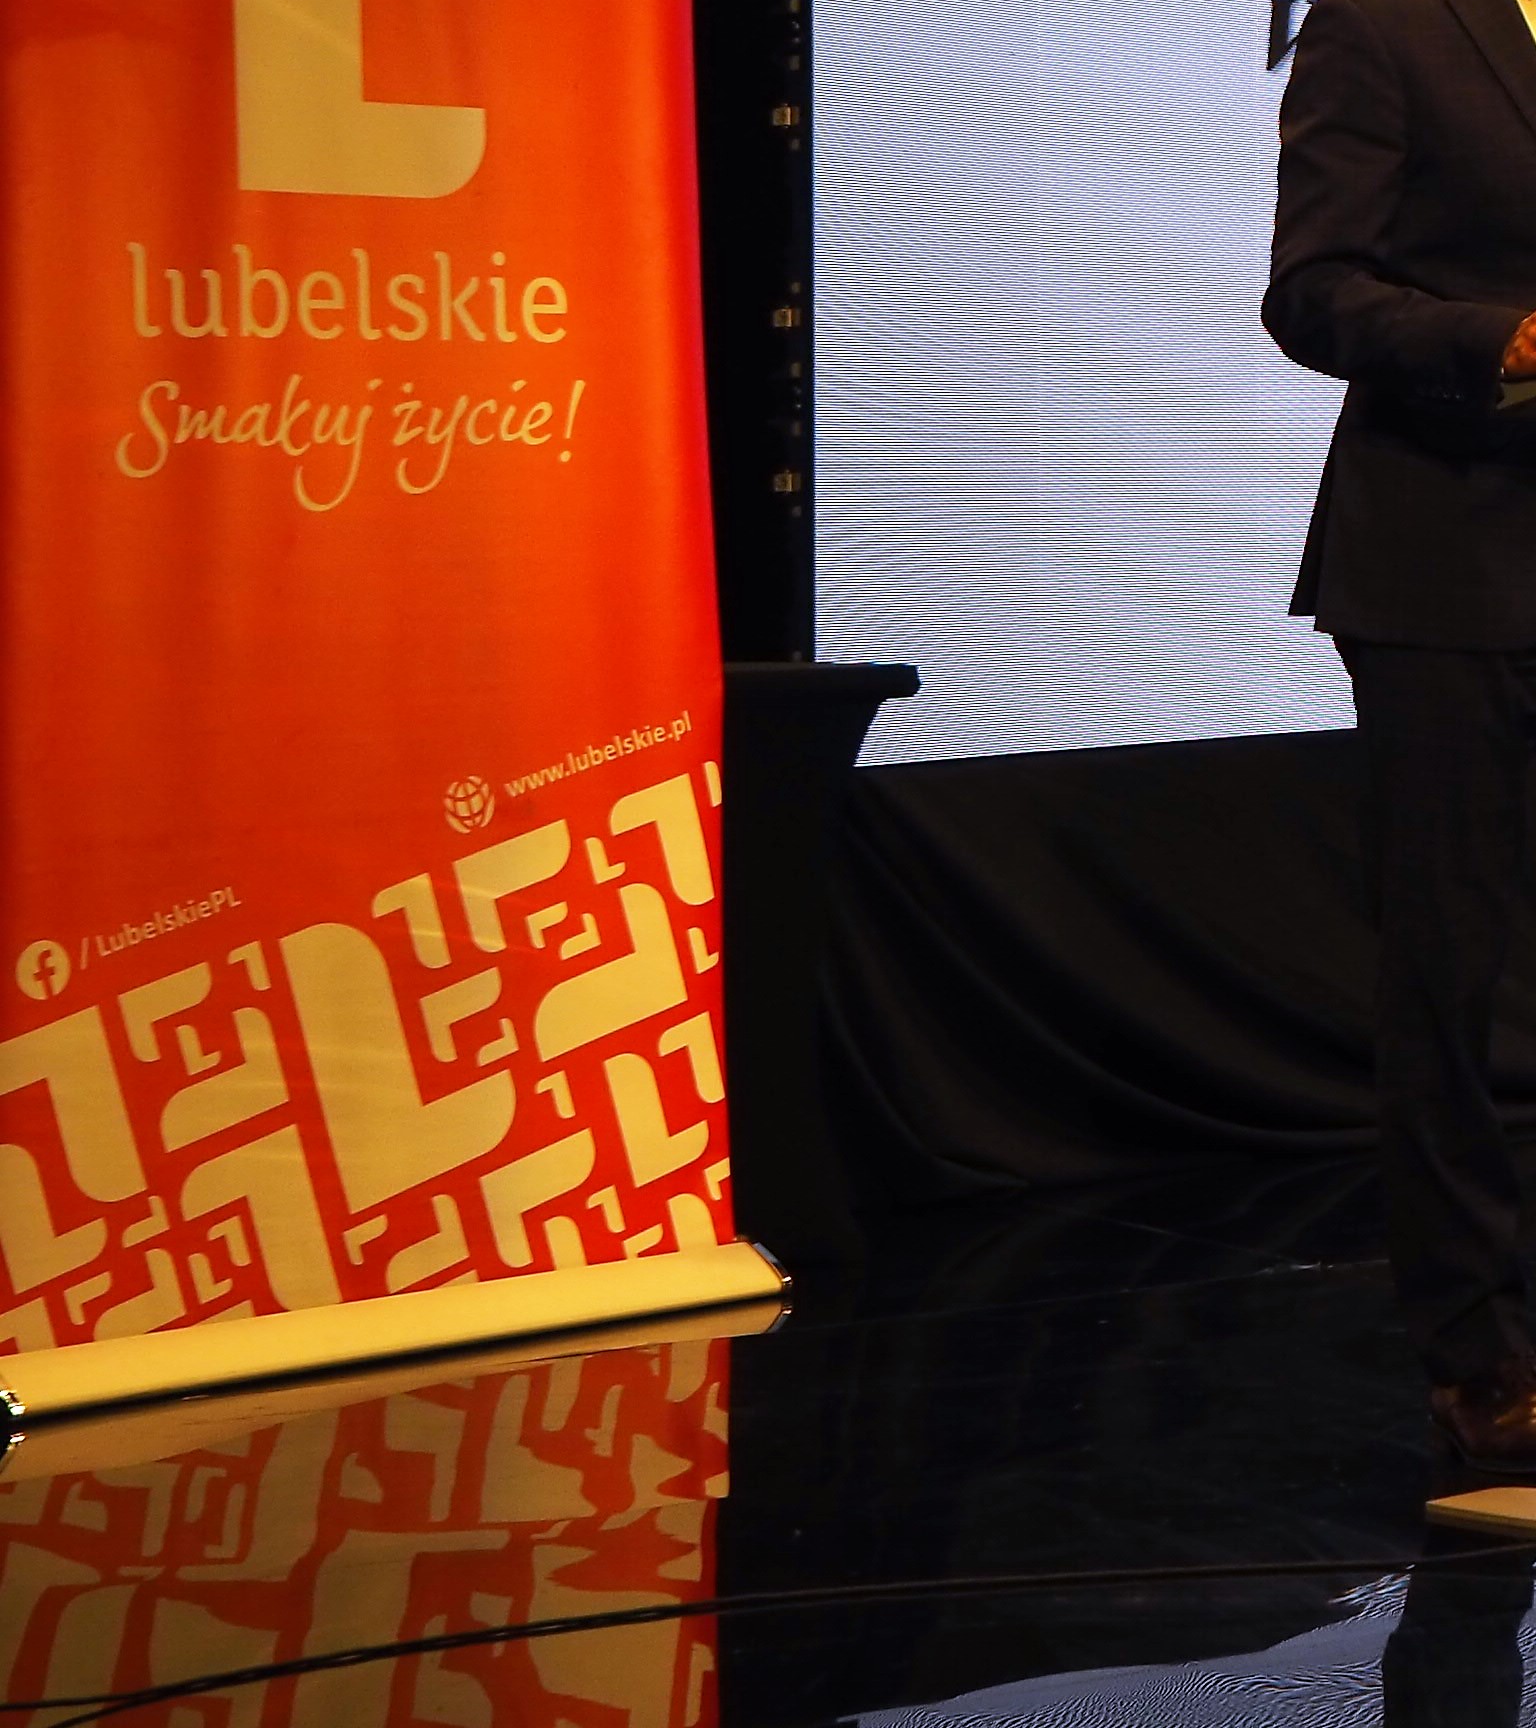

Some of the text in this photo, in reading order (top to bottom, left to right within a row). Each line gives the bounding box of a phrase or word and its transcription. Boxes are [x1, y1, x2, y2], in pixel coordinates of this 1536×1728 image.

[126, 241, 570, 346] lubelskie
[115, 373, 588, 512] Smakuj życie!
[504, 710, 692, 797] www.lubelskie.pl
